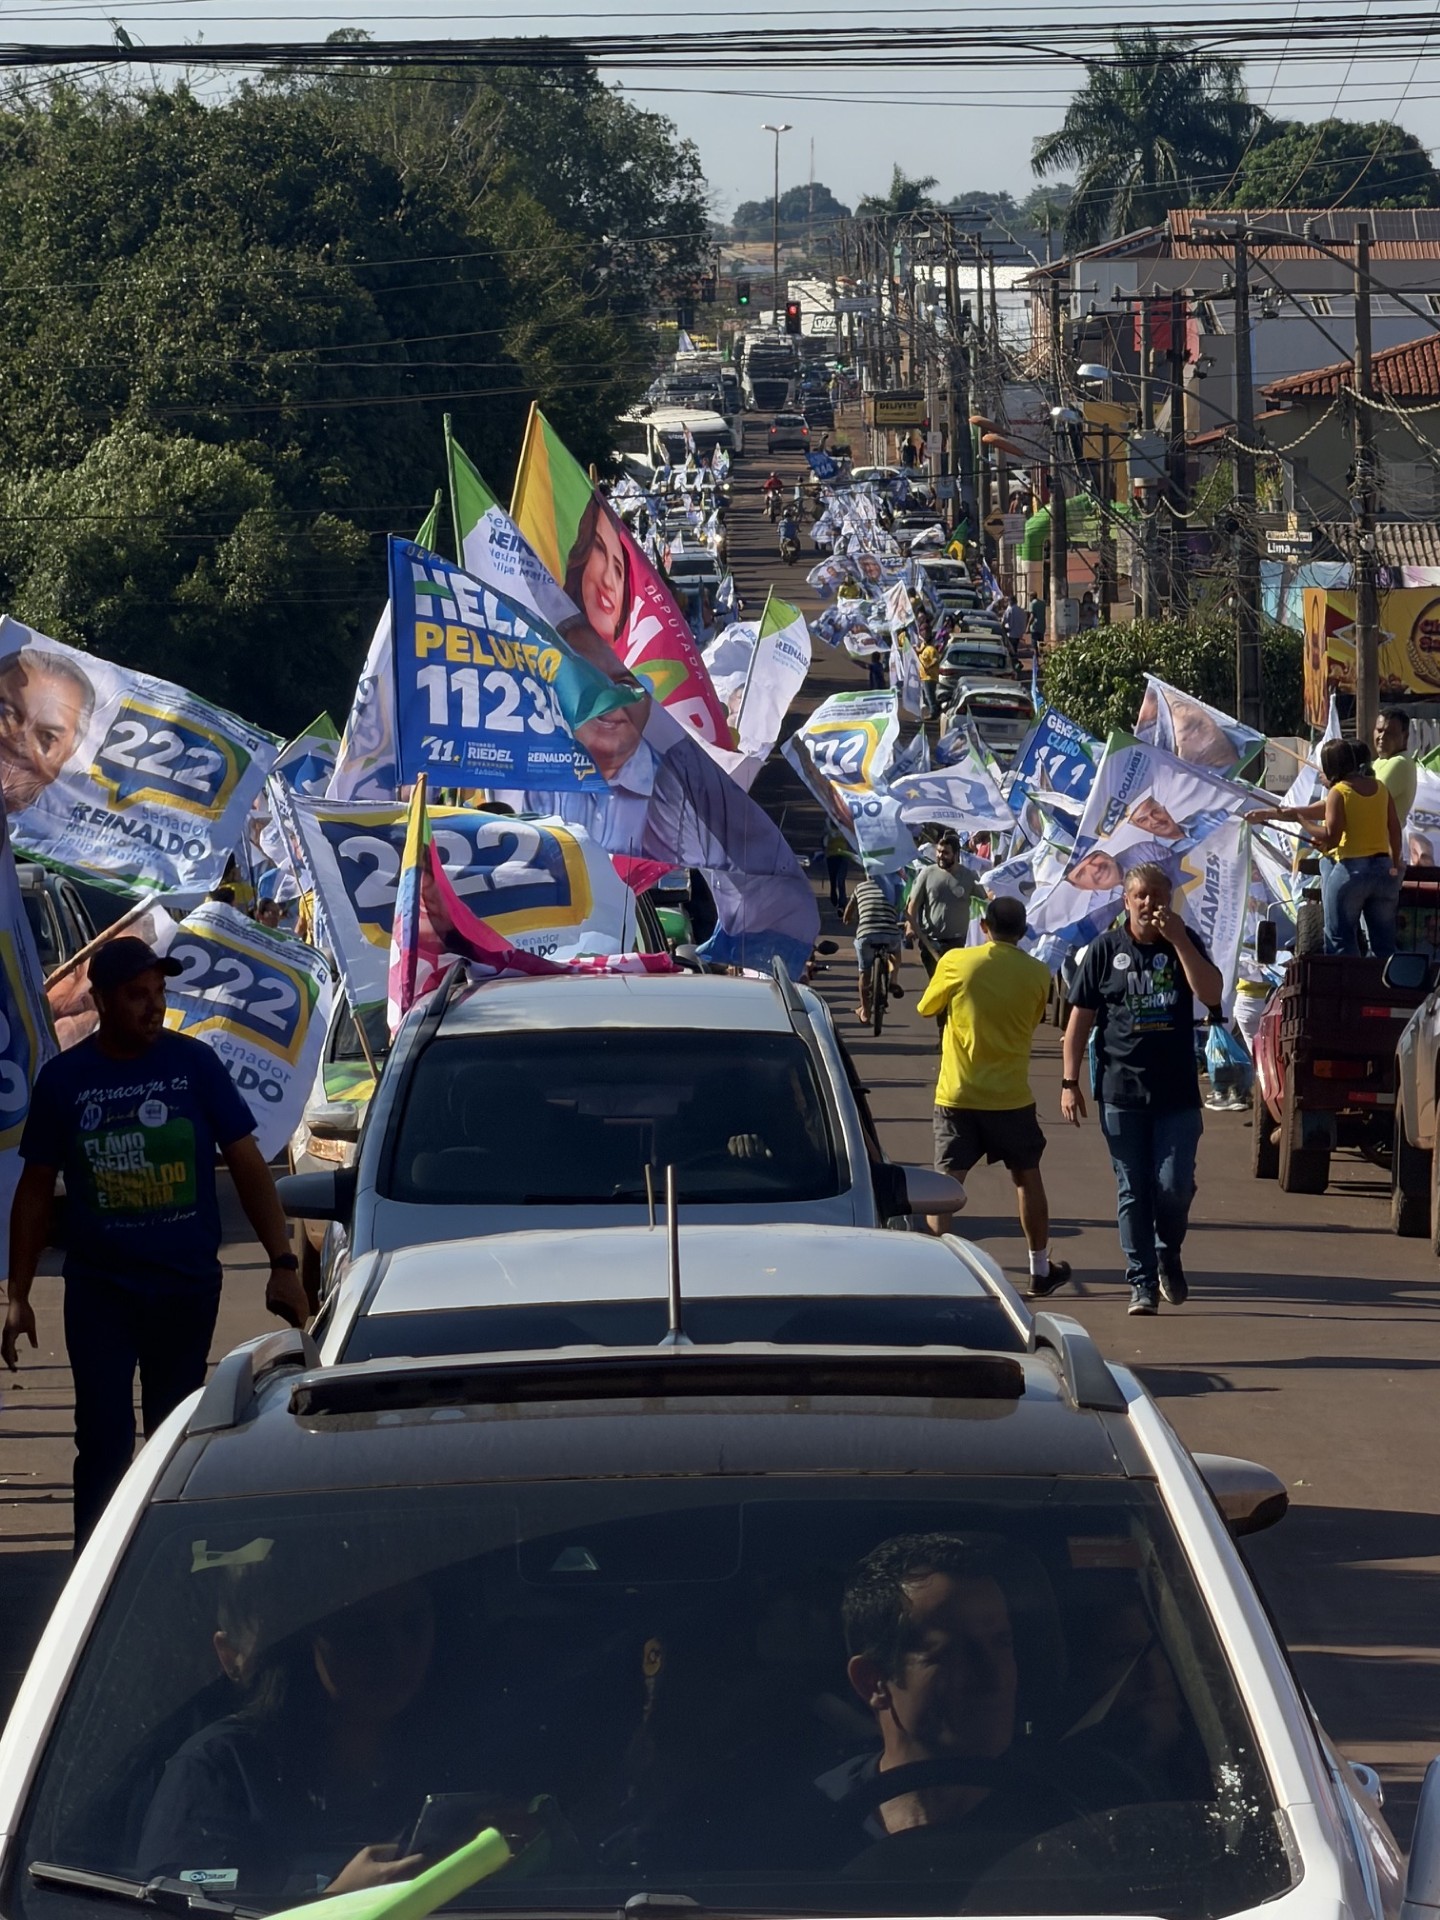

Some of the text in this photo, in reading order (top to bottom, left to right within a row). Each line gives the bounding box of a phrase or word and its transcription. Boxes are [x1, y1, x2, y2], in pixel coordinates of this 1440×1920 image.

[1267, 542, 1290, 553] Lima
[415, 621, 562, 683] PELUFFO
[644, 584, 704, 681] DEPUTADA
[100, 720, 222, 793] 222
[467, 746, 514, 762] RIEDEL
[527, 752, 572, 763] REINALDO
[71, 801, 205, 862] REINALDO
[337, 821, 556, 908] 222
[84, 1131, 146, 1157] FLÁVIO
